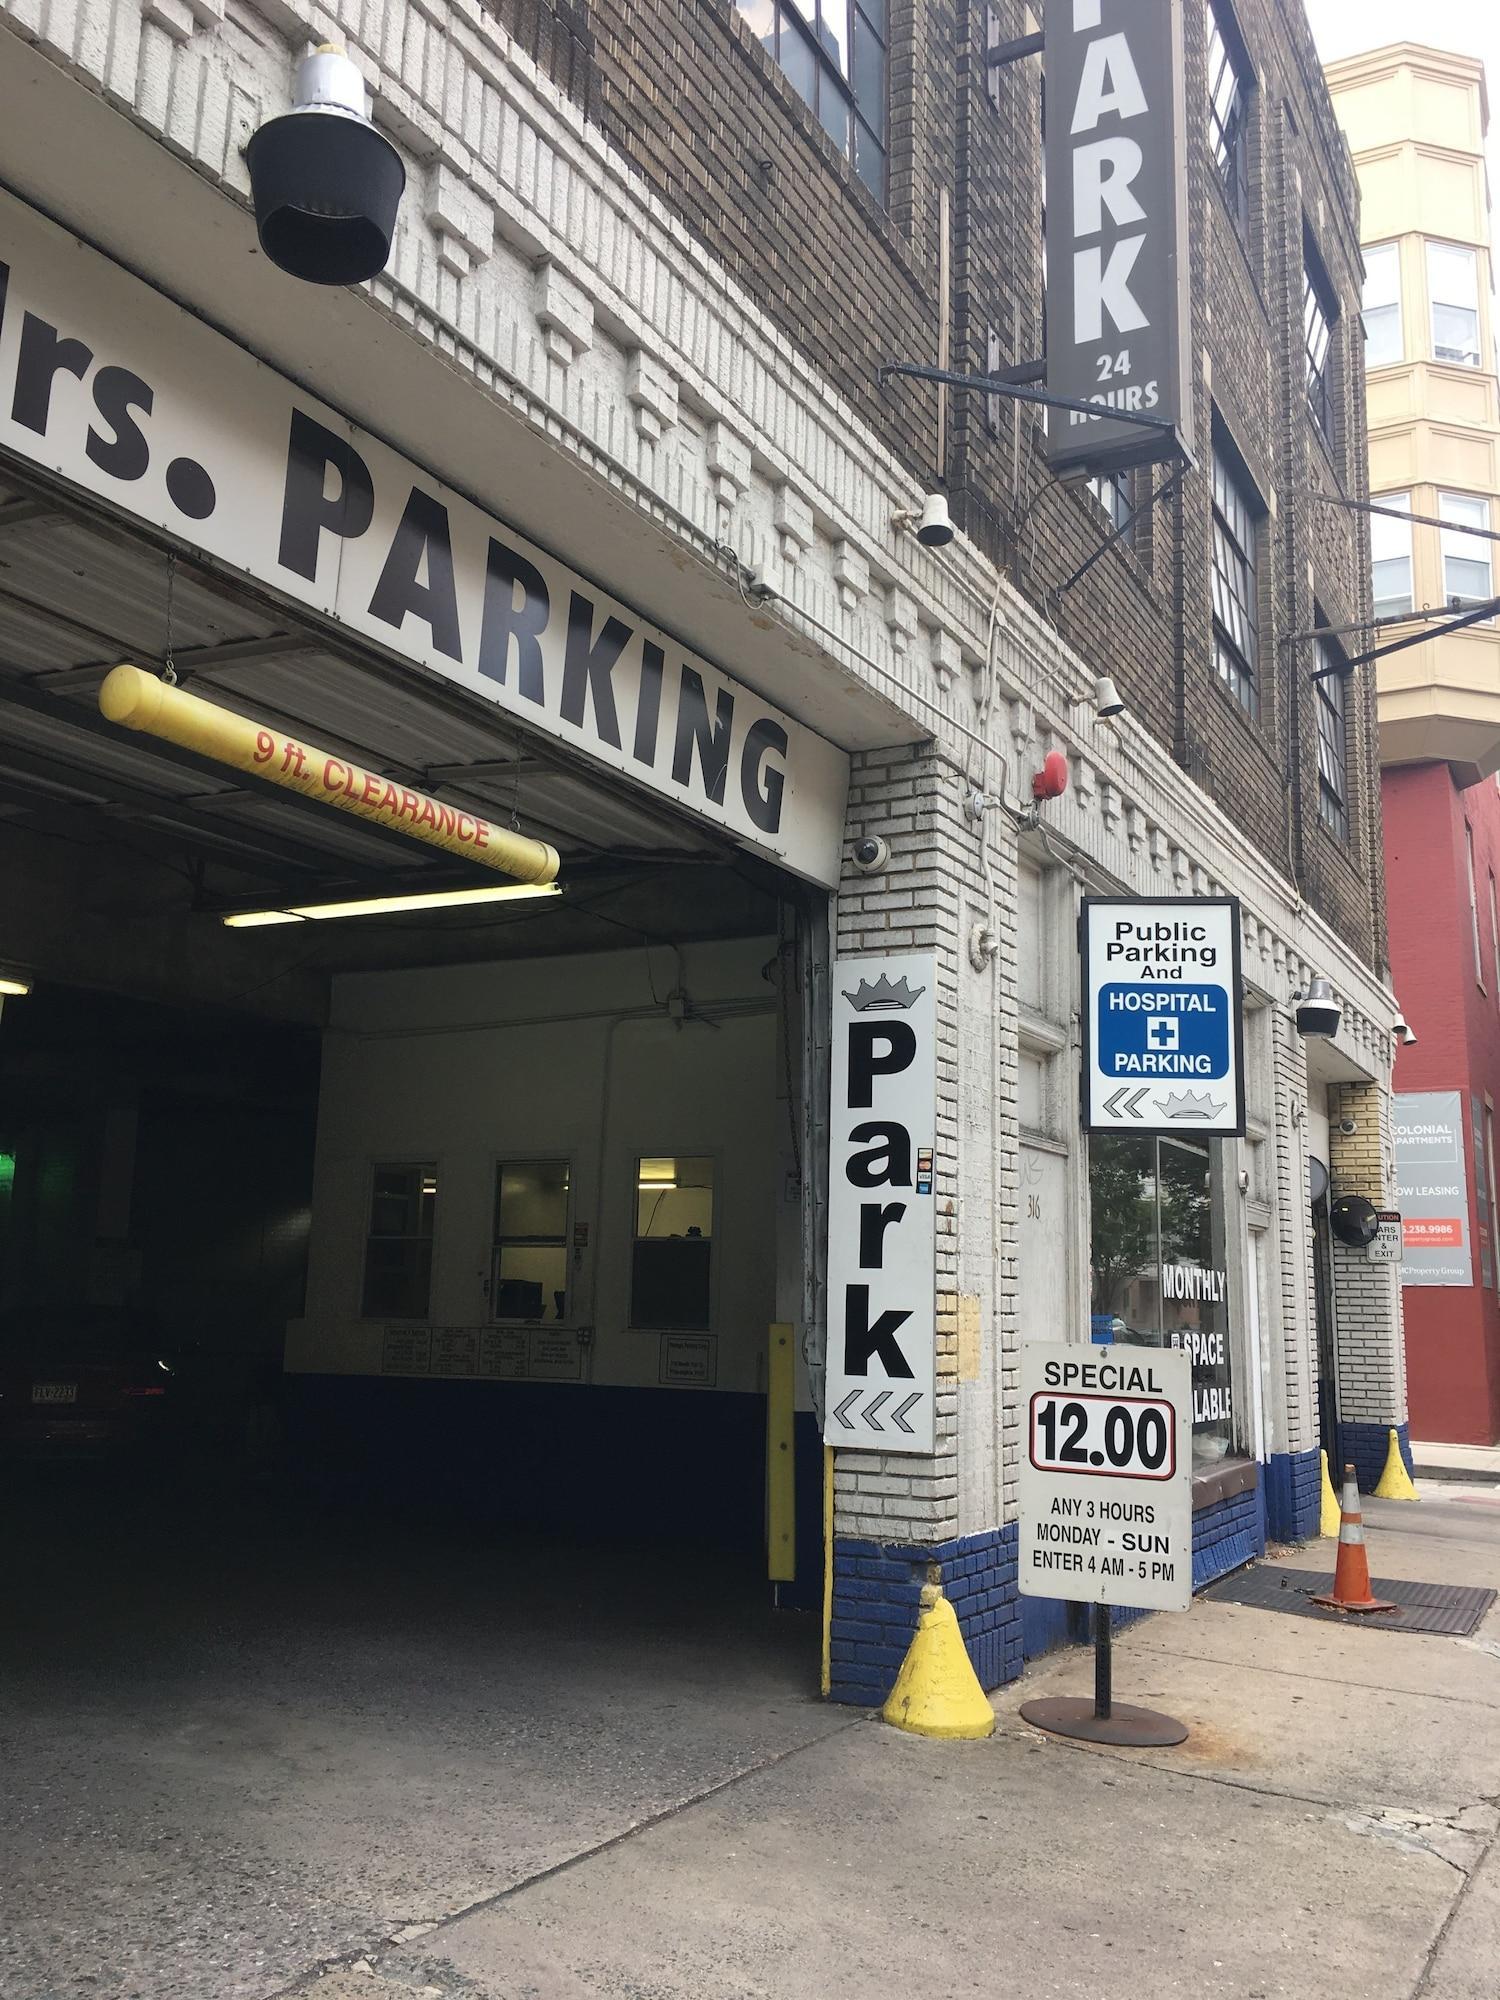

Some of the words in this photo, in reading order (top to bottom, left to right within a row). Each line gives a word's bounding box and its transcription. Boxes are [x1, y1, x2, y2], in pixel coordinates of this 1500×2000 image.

[1096, 349, 1131, 381] 24
[0, 261, 216, 520] rs.
[278, 407, 788, 834] PARKING
[253, 731, 275, 763] 9
[280, 742, 311, 781] ft.
[323, 759, 490, 848] CLEARANCE
[1115, 922, 1207, 941] Public
[1106, 943, 1217, 967] Parking
[1140, 965, 1183, 979] And
[1109, 992, 1217, 1012] HOSPITAL
[1114, 1053, 1212, 1074] PARKING
[844, 1019, 918, 1380] Park
[1027, 1194, 1041, 1220] 316
[1396, 1186, 1414, 1196] OW
[1416, 1186, 1460, 1196] LEASING
[1376, 1234, 1399, 1242] NTER
[1162, 1264, 1226, 1302] MONTHLY
[1183, 1333, 1225, 1367] SPACE
[1044, 1361, 1163, 1393] SPECIAL
[1192, 1387, 1232, 1424] LABLE
[1037, 1400, 1167, 1470] 12.00
[1050, 1497, 1083, 1518] ANY
[1086, 1500, 1095, 1518] 3
[1100, 1501, 1155, 1524] HOURS
[1037, 1523, 1102, 1546] MONDAY
[1121, 1532, 1170, 1555] SUN
[1032, 1549, 1084, 1572] ENTER
[1087, 1555, 1097, 1574] 4
[1100, 1555, 1124, 1577] AM
[1138, 1561, 1147, 1579] 5
[1151, 1562, 1175, 1582] PM
